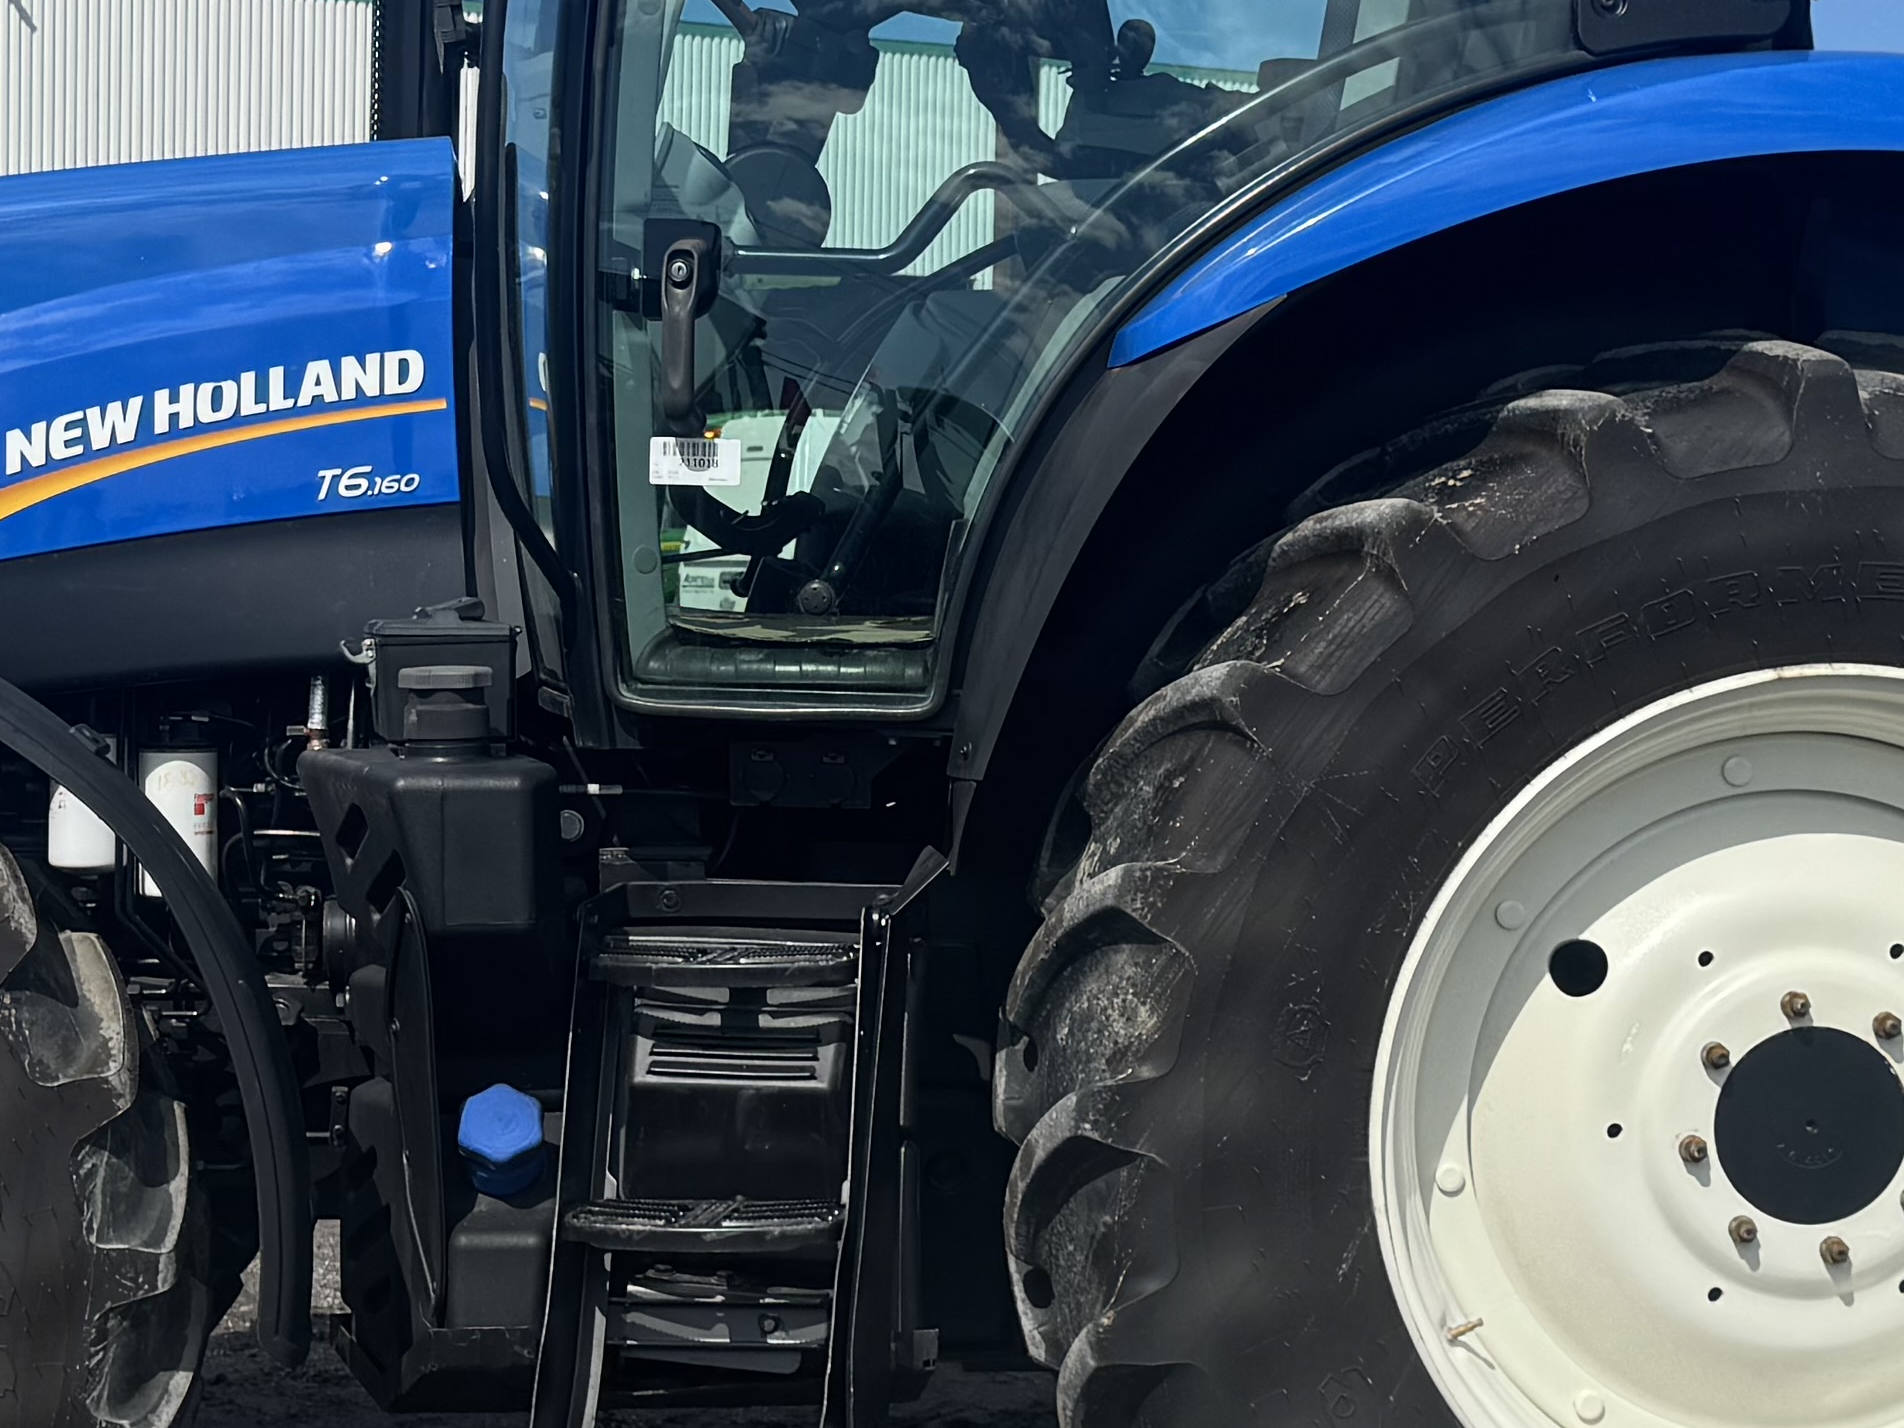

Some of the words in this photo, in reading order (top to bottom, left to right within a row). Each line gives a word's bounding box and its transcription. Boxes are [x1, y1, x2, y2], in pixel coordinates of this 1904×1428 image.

[5, 395, 144, 476] NEW
[154, 349, 425, 436] HOLLAND
[317, 466, 421, 501] T6.160
